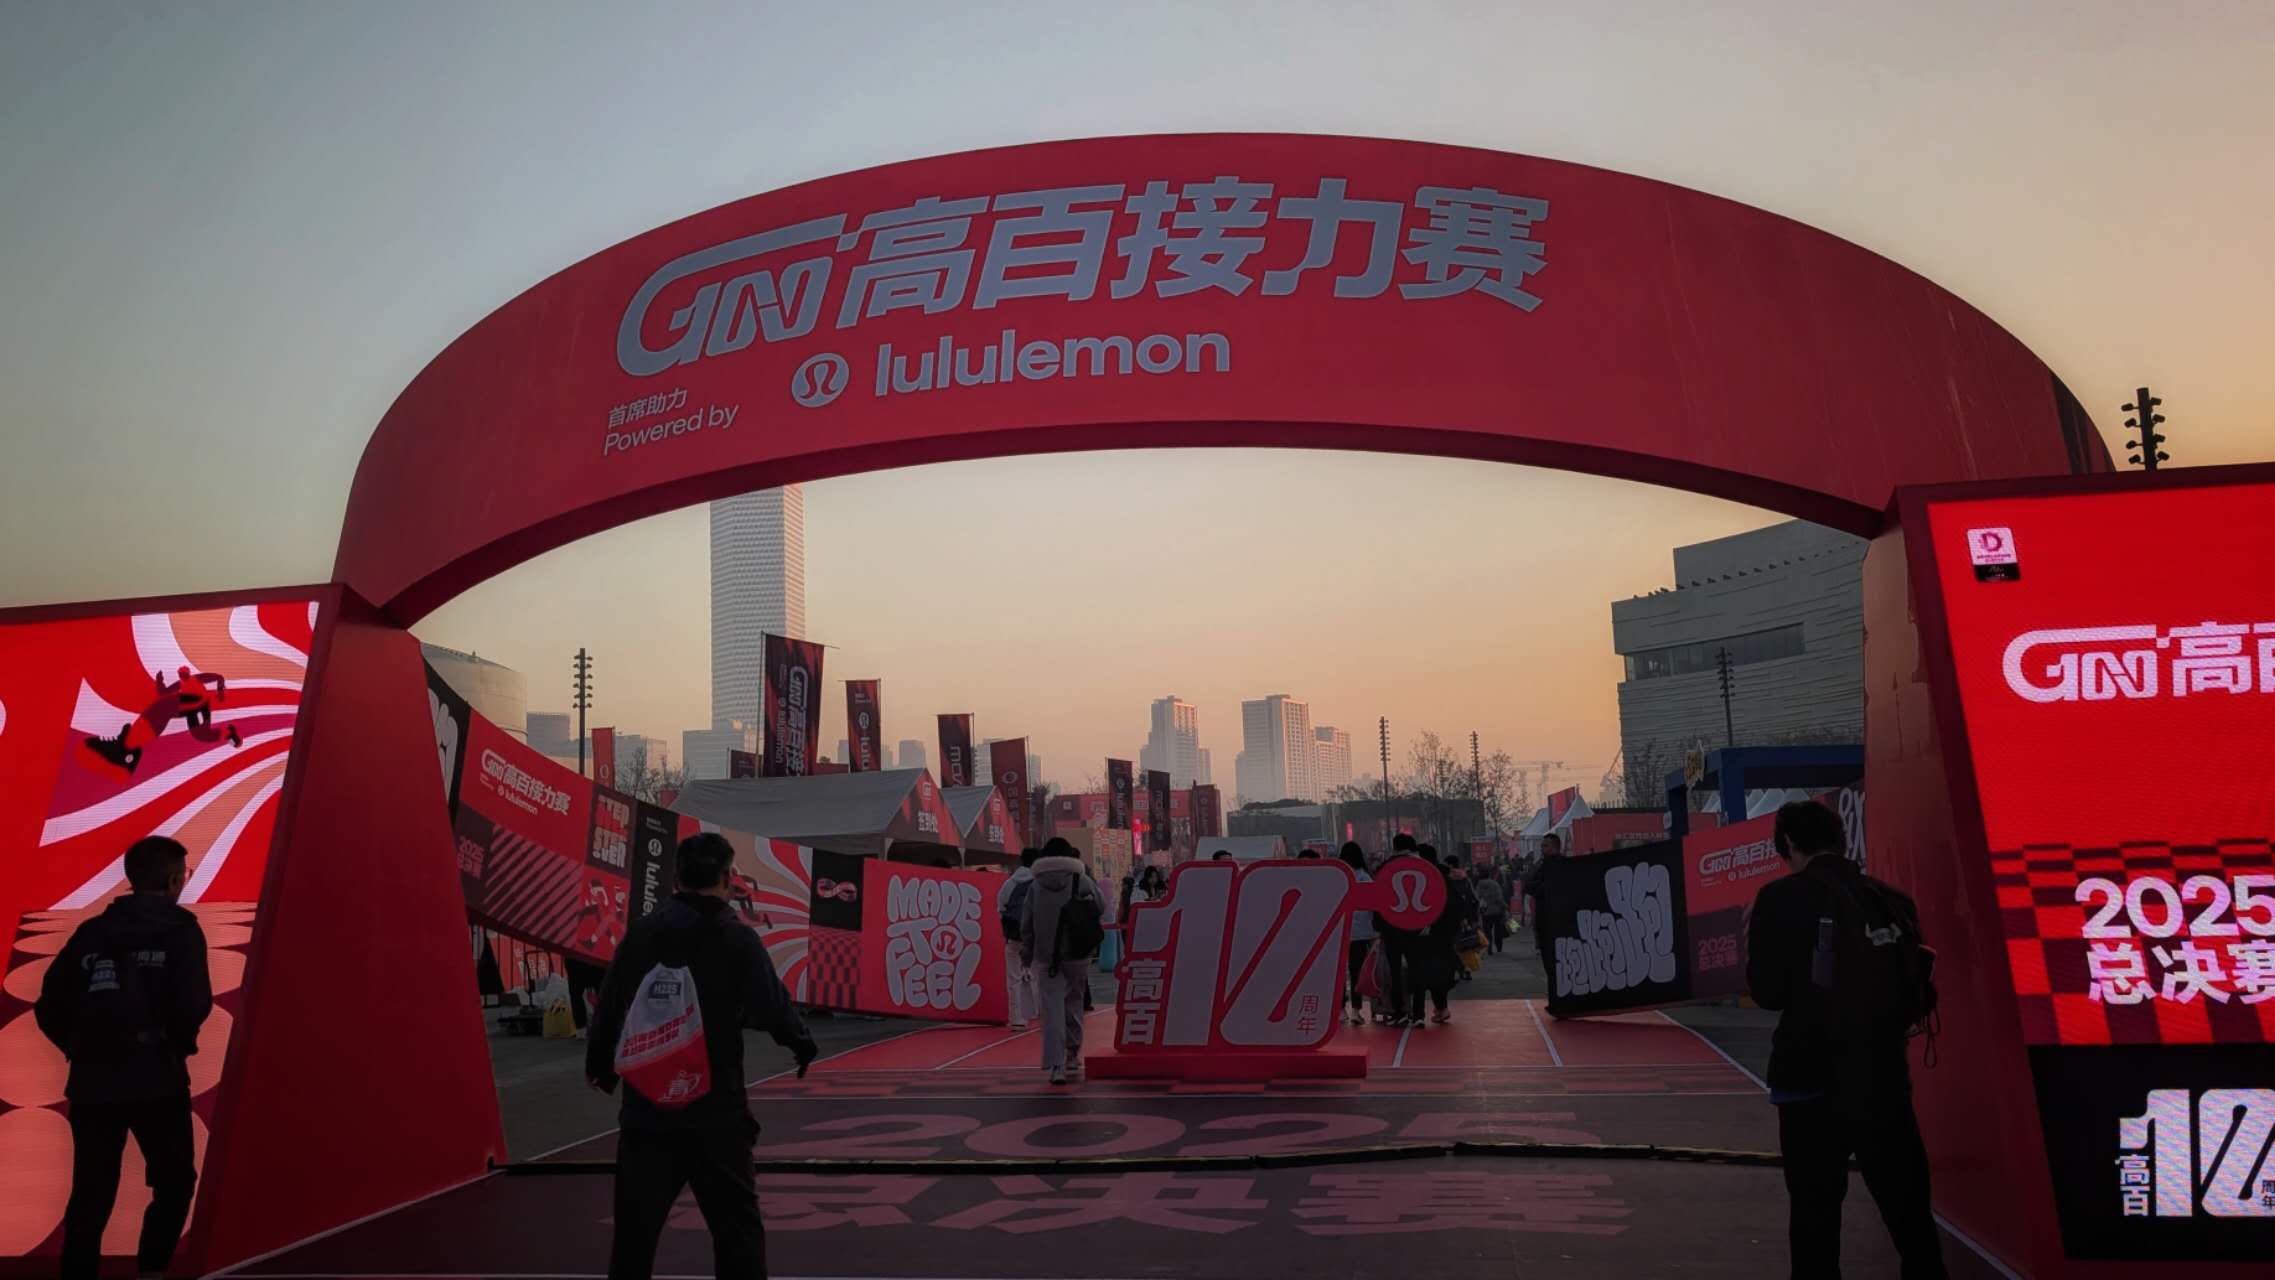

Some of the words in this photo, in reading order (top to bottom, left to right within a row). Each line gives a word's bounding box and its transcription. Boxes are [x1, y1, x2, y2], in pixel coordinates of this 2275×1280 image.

[836, 176, 1549, 328] 高百接力赛
[875, 329, 1230, 396] lululemon
[604, 408, 701, 455] Powered
[709, 405, 739, 427] by
[607, 388, 688, 428] 首席助力
[2156, 621, 2275, 697] 高
[642, 861, 661, 917] lulule
[886, 874, 981, 942] MADE
[2075, 874, 2275, 939] 2025
[885, 937, 981, 1010] FEEL
[1131, 866, 1349, 1046] 10
[1698, 934, 1737, 955] 2025
[1120, 958, 1168, 1046] 高百
[1296, 994, 1319, 1034] 周年
[755, 1111, 1602, 1158] 2025
[2115, 1153, 2151, 1217] 高百
